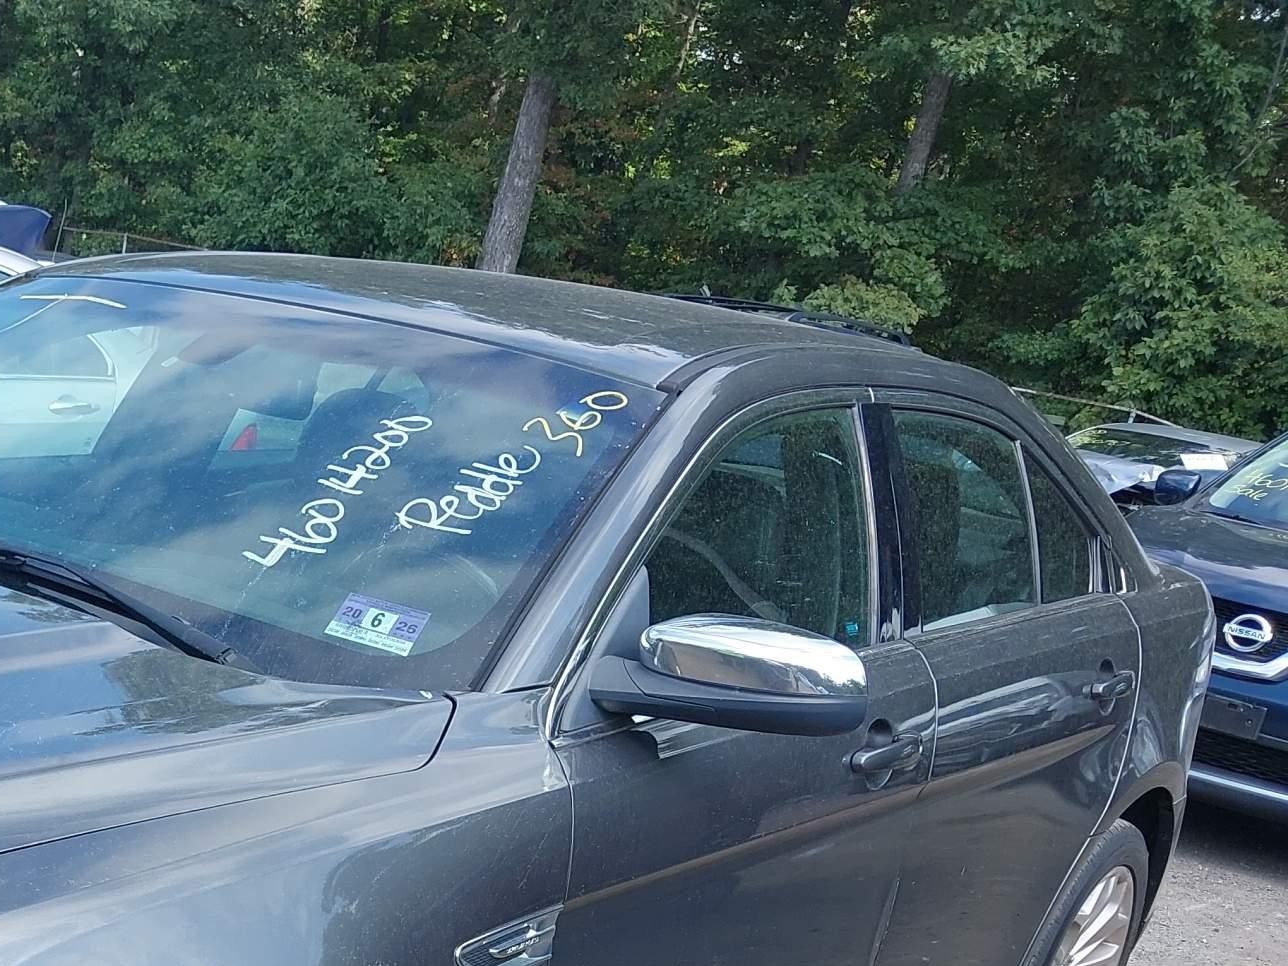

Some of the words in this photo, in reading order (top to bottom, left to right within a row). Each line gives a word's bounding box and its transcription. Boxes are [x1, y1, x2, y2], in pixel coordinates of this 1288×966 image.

[521, 390, 629, 457] 360
[342, 606, 363, 619] 20
[370, 612, 386, 628] 6
[395, 621, 419, 634] 26
[1227, 625, 1266, 640] NISSAN
